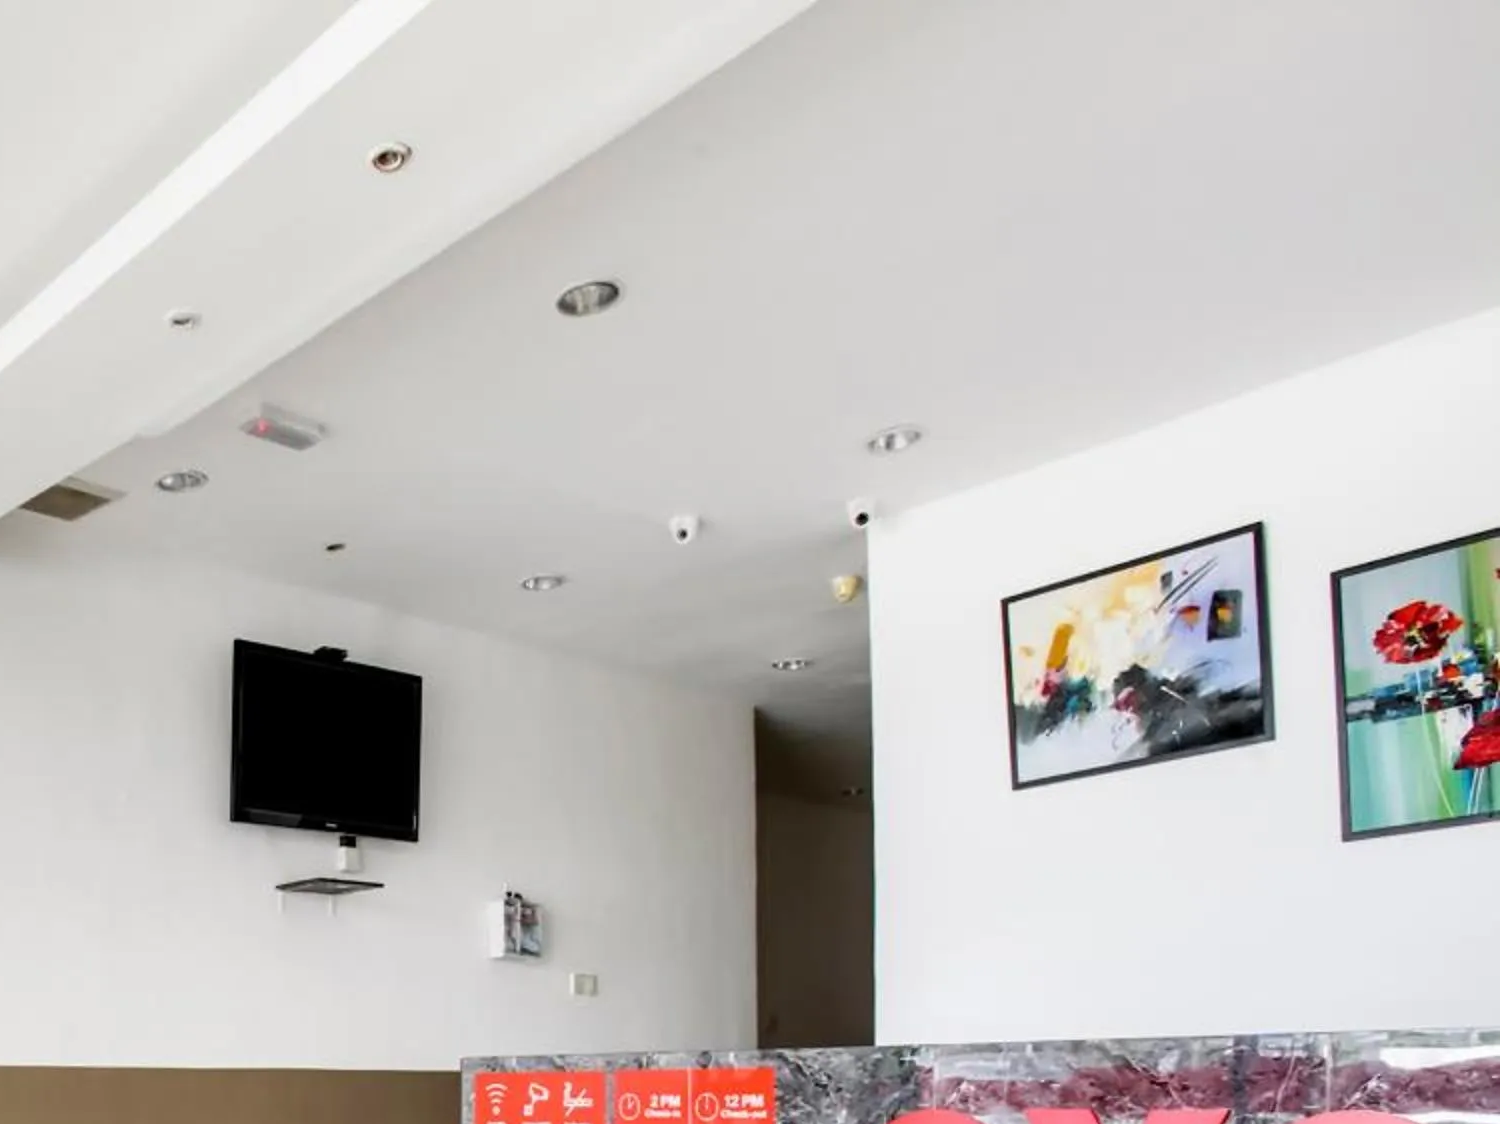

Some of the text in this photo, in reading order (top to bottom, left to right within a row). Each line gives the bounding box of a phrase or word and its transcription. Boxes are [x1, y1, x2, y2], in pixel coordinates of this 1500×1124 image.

[660, 1094, 681, 1108] PM
[724, 1094, 765, 1108] 12 PM
